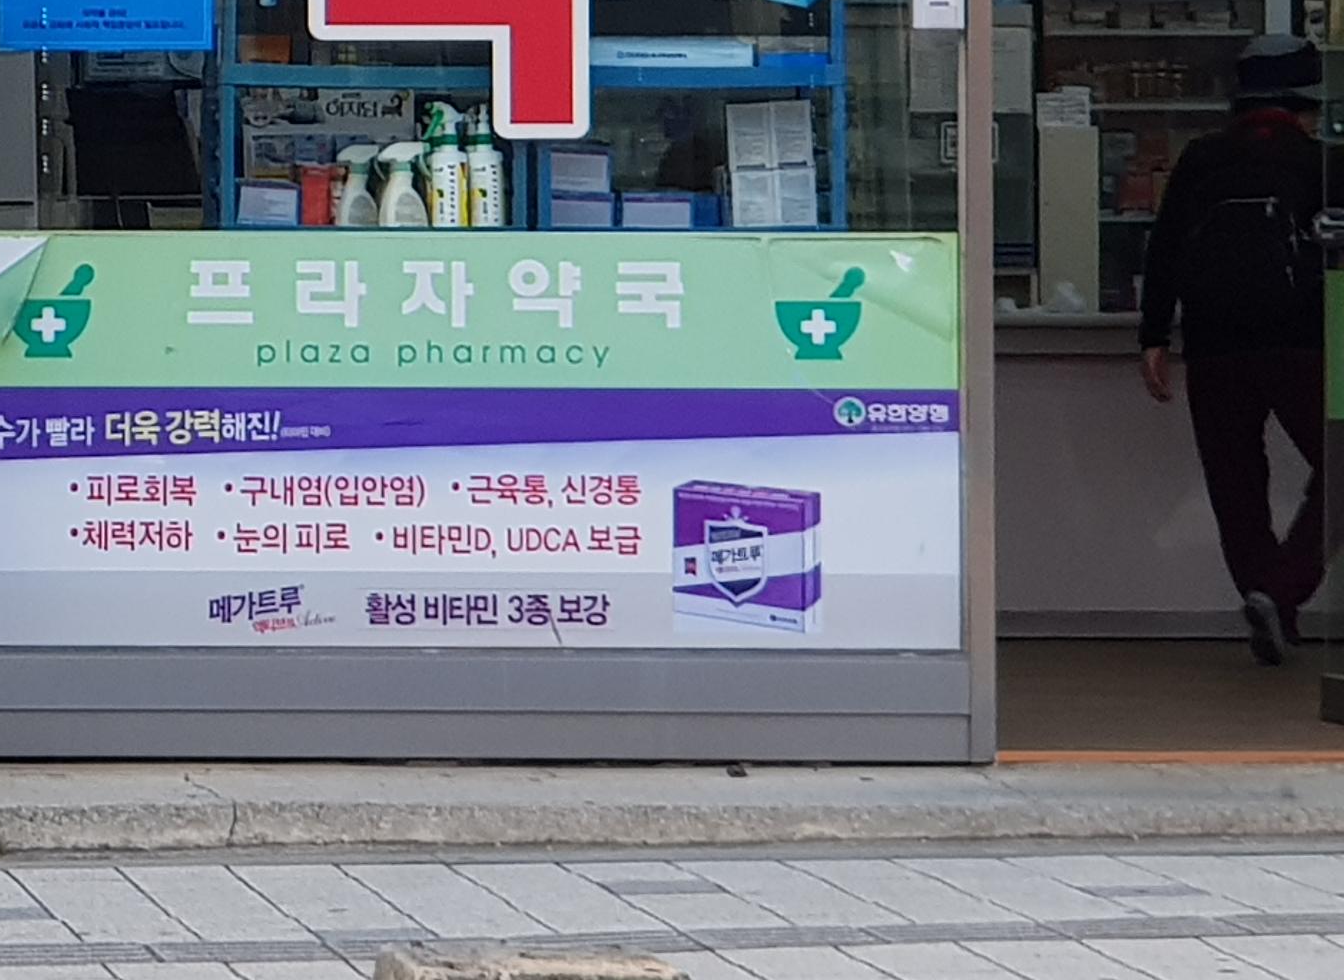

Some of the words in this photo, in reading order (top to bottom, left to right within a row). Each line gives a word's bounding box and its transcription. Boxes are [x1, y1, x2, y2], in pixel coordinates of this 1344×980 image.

[186, 259, 684, 328] 프라자약국
[255, 339, 370, 368] plaza
[397, 339, 610, 368] pharmacy
[46, 417, 94, 447] 빨라
[105, 411, 161, 446] 더욱
[165, 408, 281, 445] 강력해진!
[867, 403, 949, 422] 유한양행
[86, 475, 197, 506] 피로회복
[240, 475, 425, 507] 구내염(입안염)
[467, 474, 553, 507] 근육통,
[561, 475, 642, 506] 신경통
[82, 520, 193, 552] 체력저하
[233, 522, 287, 554] 눈의
[295, 523, 350, 554] 피로
[393, 525, 497, 558] 비타민D,
[507, 527, 581, 552] UDCA
[587, 525, 642, 555] 보급
[209, 586, 302, 624] 메가트루
[365, 592, 417, 627] 활성
[424, 593, 499, 626] 비타민
[507, 594, 552, 627] 3종
[557, 593, 611, 627] 보강
